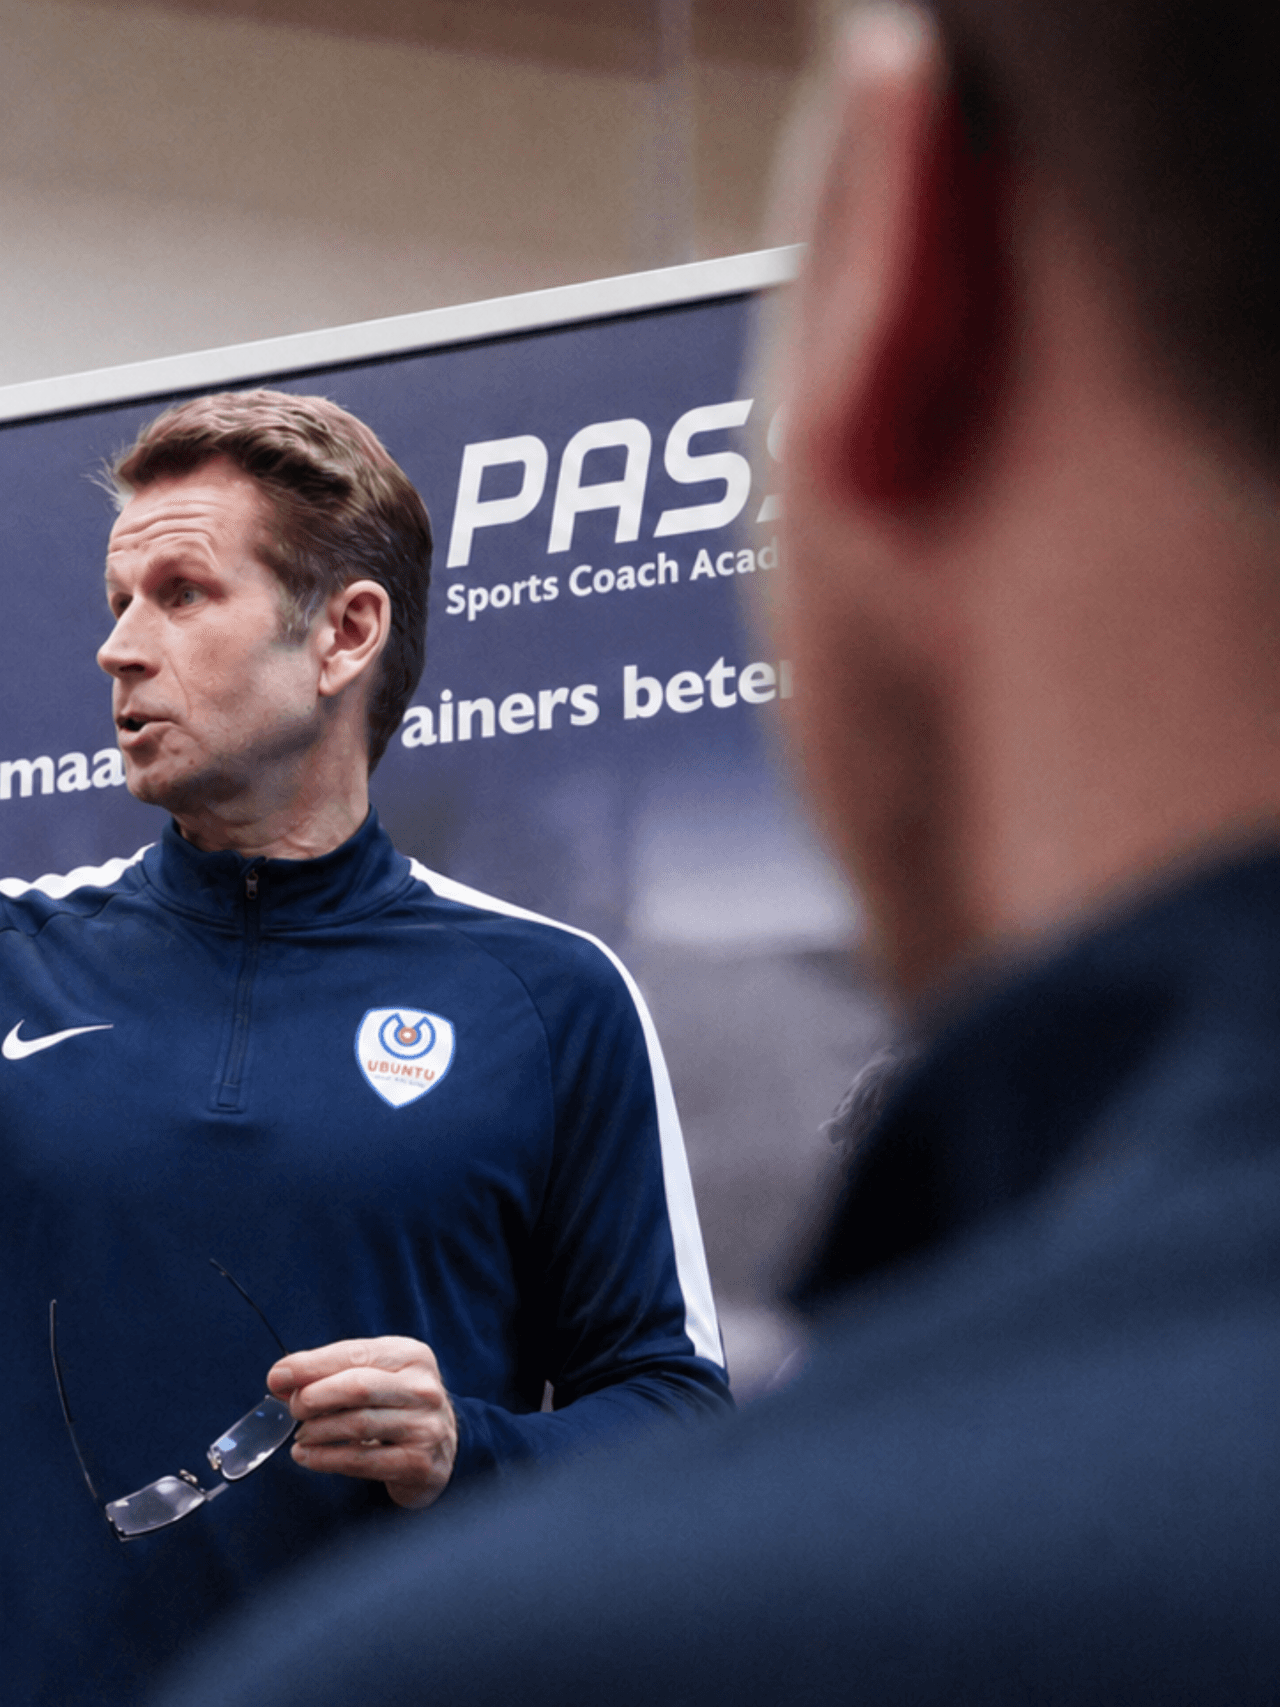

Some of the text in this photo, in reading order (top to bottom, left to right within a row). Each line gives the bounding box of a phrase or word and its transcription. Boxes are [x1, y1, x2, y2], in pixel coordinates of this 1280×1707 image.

[446, 398, 782, 568] PAS
[446, 535, 779, 622] Sports Coach Acad
[400, 683, 600, 749] ainers
[366, 1059, 436, 1082] UBUNTU
